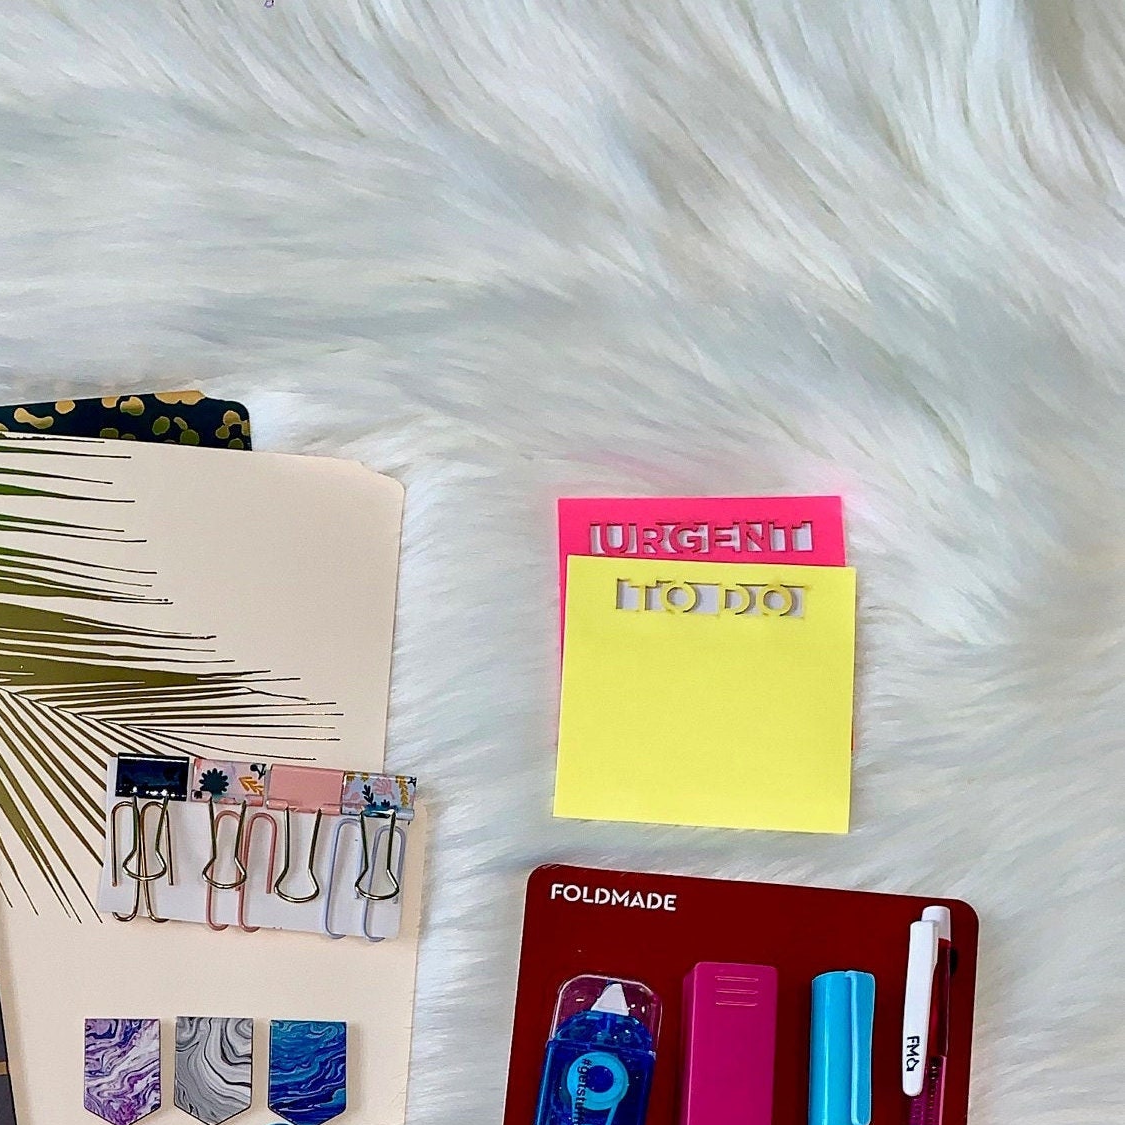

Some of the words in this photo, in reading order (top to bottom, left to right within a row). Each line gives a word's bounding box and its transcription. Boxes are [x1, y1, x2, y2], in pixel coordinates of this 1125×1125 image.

[594, 521, 807, 553] URGENT
[624, 579, 698, 614] TO
[719, 583, 794, 617] DO
[550, 883, 677, 911] FOLDMADE
